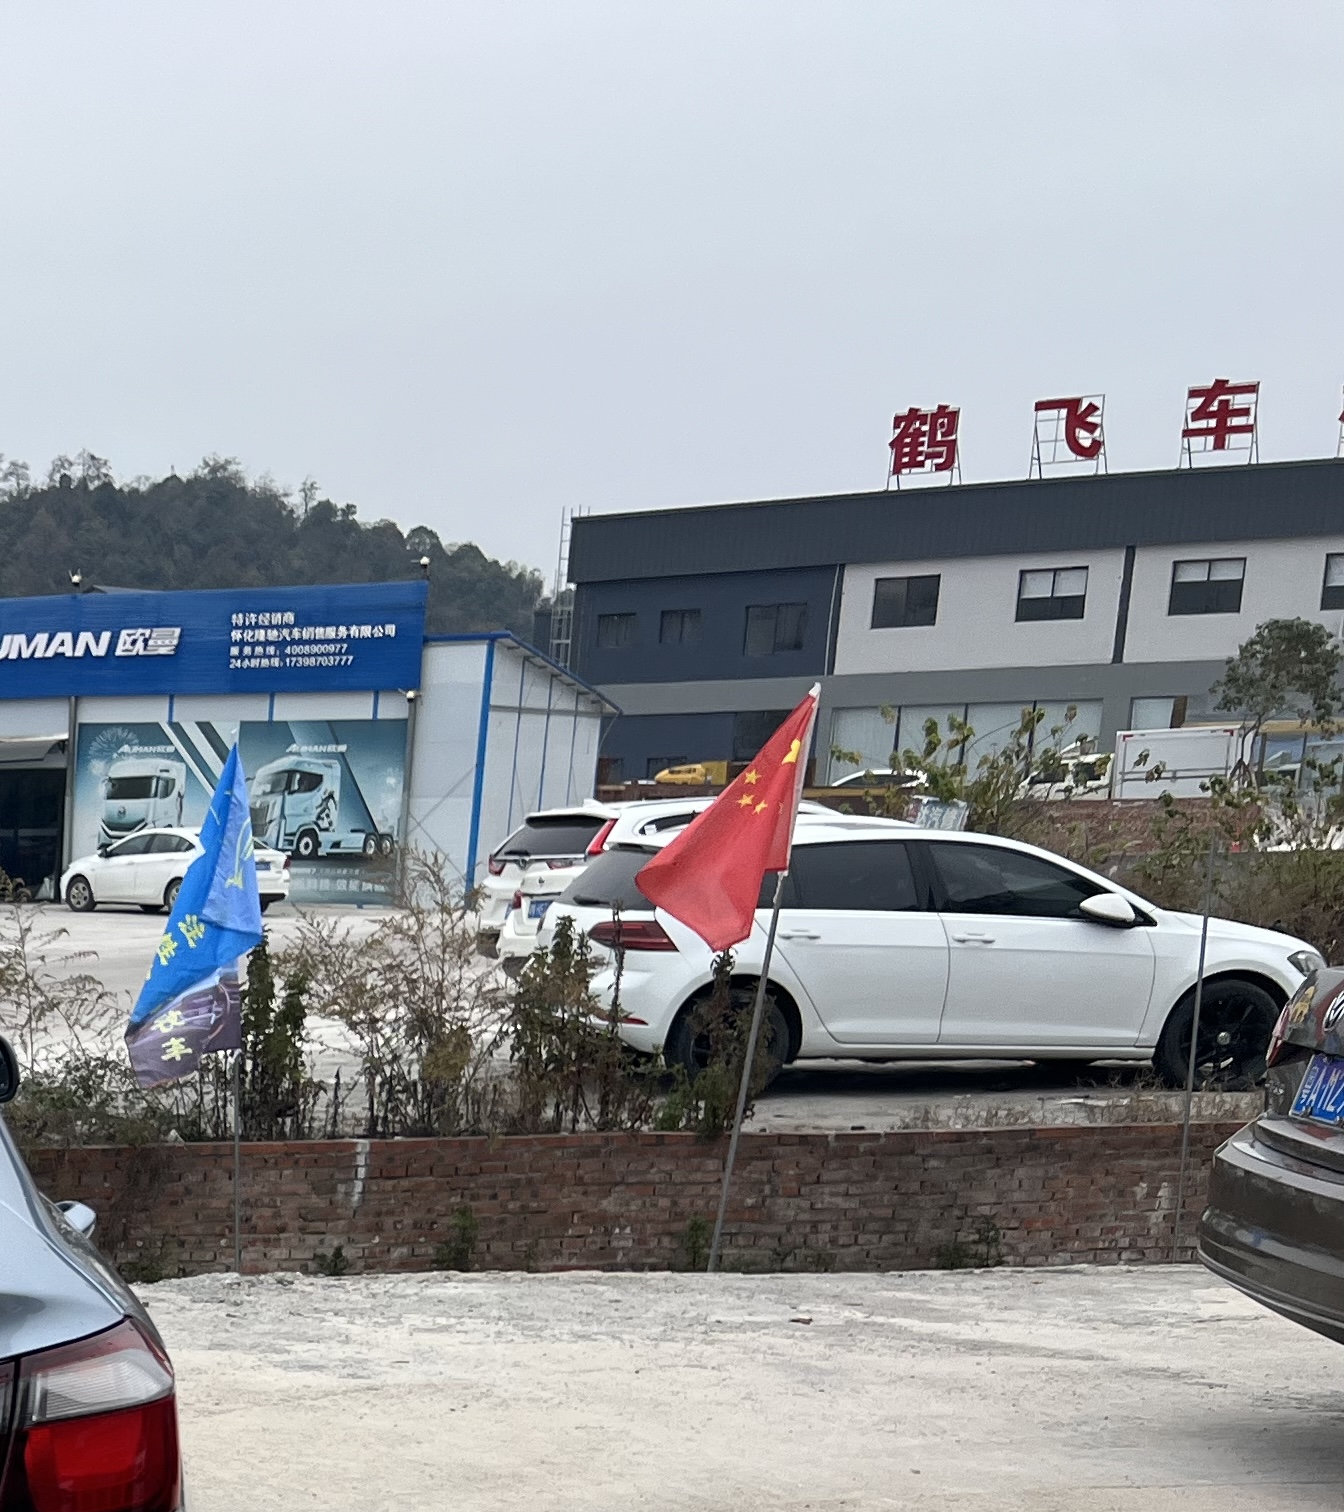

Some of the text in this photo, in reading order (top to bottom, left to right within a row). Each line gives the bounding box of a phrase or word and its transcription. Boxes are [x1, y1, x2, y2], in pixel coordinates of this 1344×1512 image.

[888, 378, 1344, 475] 鹤飞车
[231, 611, 295, 627] 特许经销商
[115, 627, 182, 657] 欧曼
